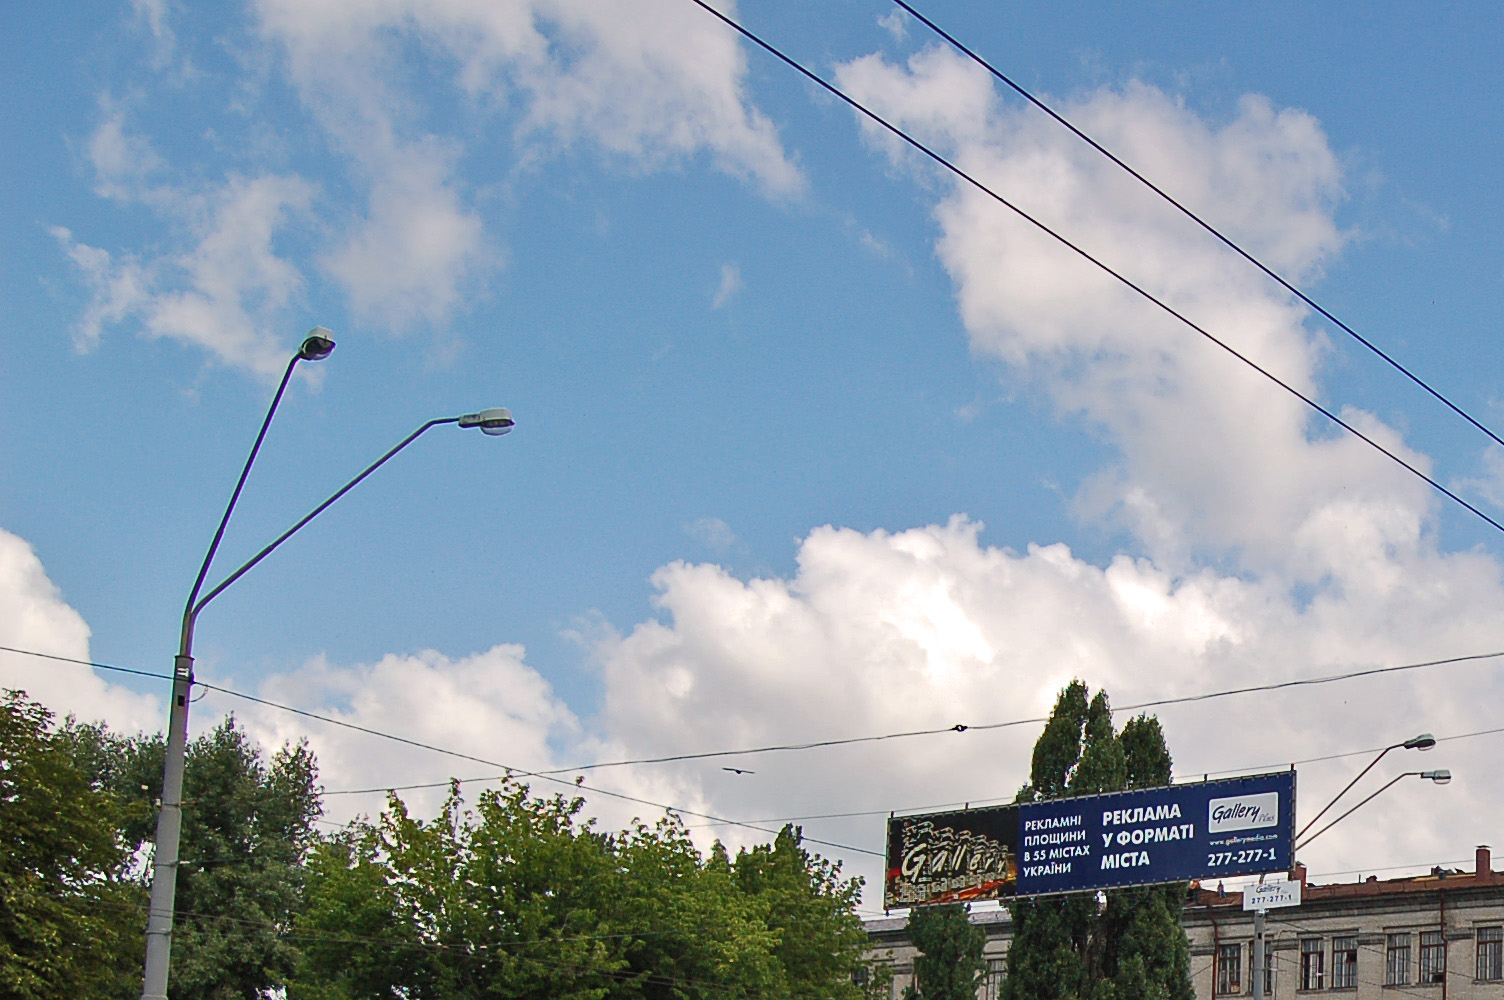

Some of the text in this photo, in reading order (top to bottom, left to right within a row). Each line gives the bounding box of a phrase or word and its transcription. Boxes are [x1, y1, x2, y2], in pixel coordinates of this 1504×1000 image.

[1102, 803, 1181, 826] РЕКЛАМА
[1212, 802, 1261, 823] Gallery
[1025, 815, 1081, 831] РЕКЛАМНІ
[1024, 830, 1086, 846] ПЛОЩИНИ
[1102, 824, 1194, 848] У ФОРМАТІ
[1024, 844, 1090, 862] В 55 МІСТАХ
[1100, 851, 1150, 870] МІСТА
[1207, 848, 1276, 867] 277-277-1
[1023, 862, 1072, 878] УКРАЇНИ
[1252, 894, 1292, 904] 277-277-1
